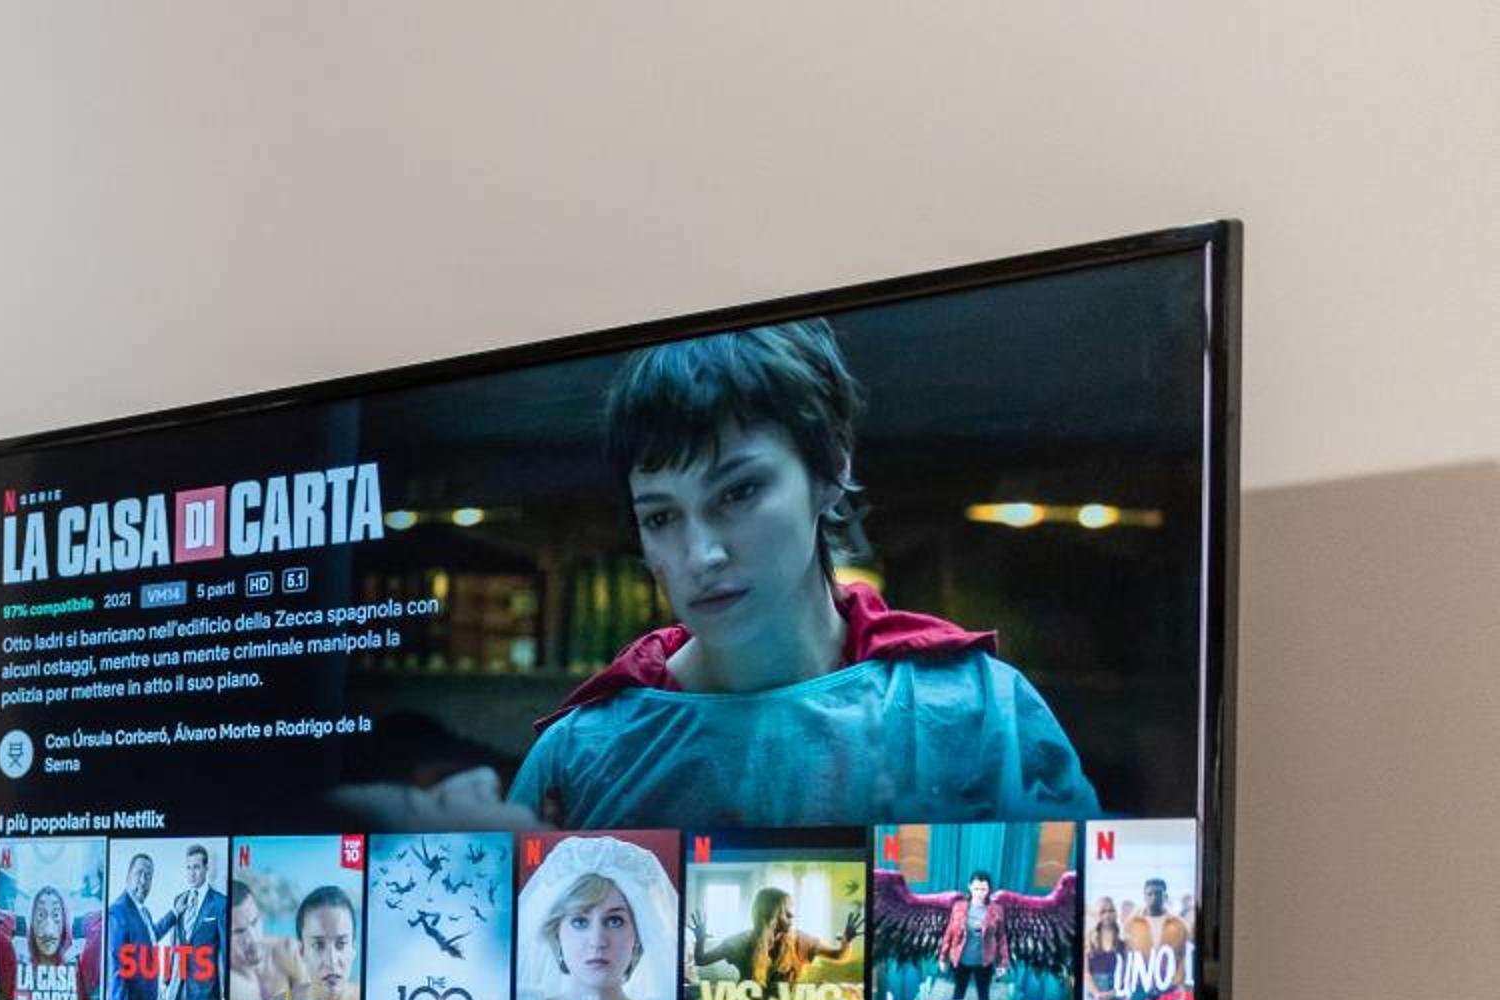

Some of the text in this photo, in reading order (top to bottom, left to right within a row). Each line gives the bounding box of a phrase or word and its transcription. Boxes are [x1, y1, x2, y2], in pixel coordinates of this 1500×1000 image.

[3, 461, 385, 585] LA CASA DI CARTA
[3, 604, 29, 619] 97%
[30, 597, 95, 617] compatibile
[103, 592, 132, 609] 2021
[196, 583, 205, 598] 5
[207, 580, 236, 601] parti
[249, 576, 270, 593] HD
[286, 571, 305, 589] 5.1
[2, 598, 439, 653] Otto ladri si barricano nell'edificio della Zecca spagnola con
[2, 628, 401, 679] alcuni ostaggi, mentre una mente criminale manipola la
[1, 672, 264, 709] polizia per mettere in atto il suo piano.
[45, 714, 372, 749] Con Úrsula Corberó, Álvaro Morte e Rodrigo de la
[6, 813, 27, 835] più
[31, 811, 90, 835] popolari
[93, 814, 111, 830] su
[113, 809, 166, 830] Netflix
[344, 849, 360, 862] 10
[17, 962, 77, 992] LA CASA
[118, 943, 216, 981] SUITS
[1113, 943, 1176, 999] UNO
[426, 975, 447, 989] THE
